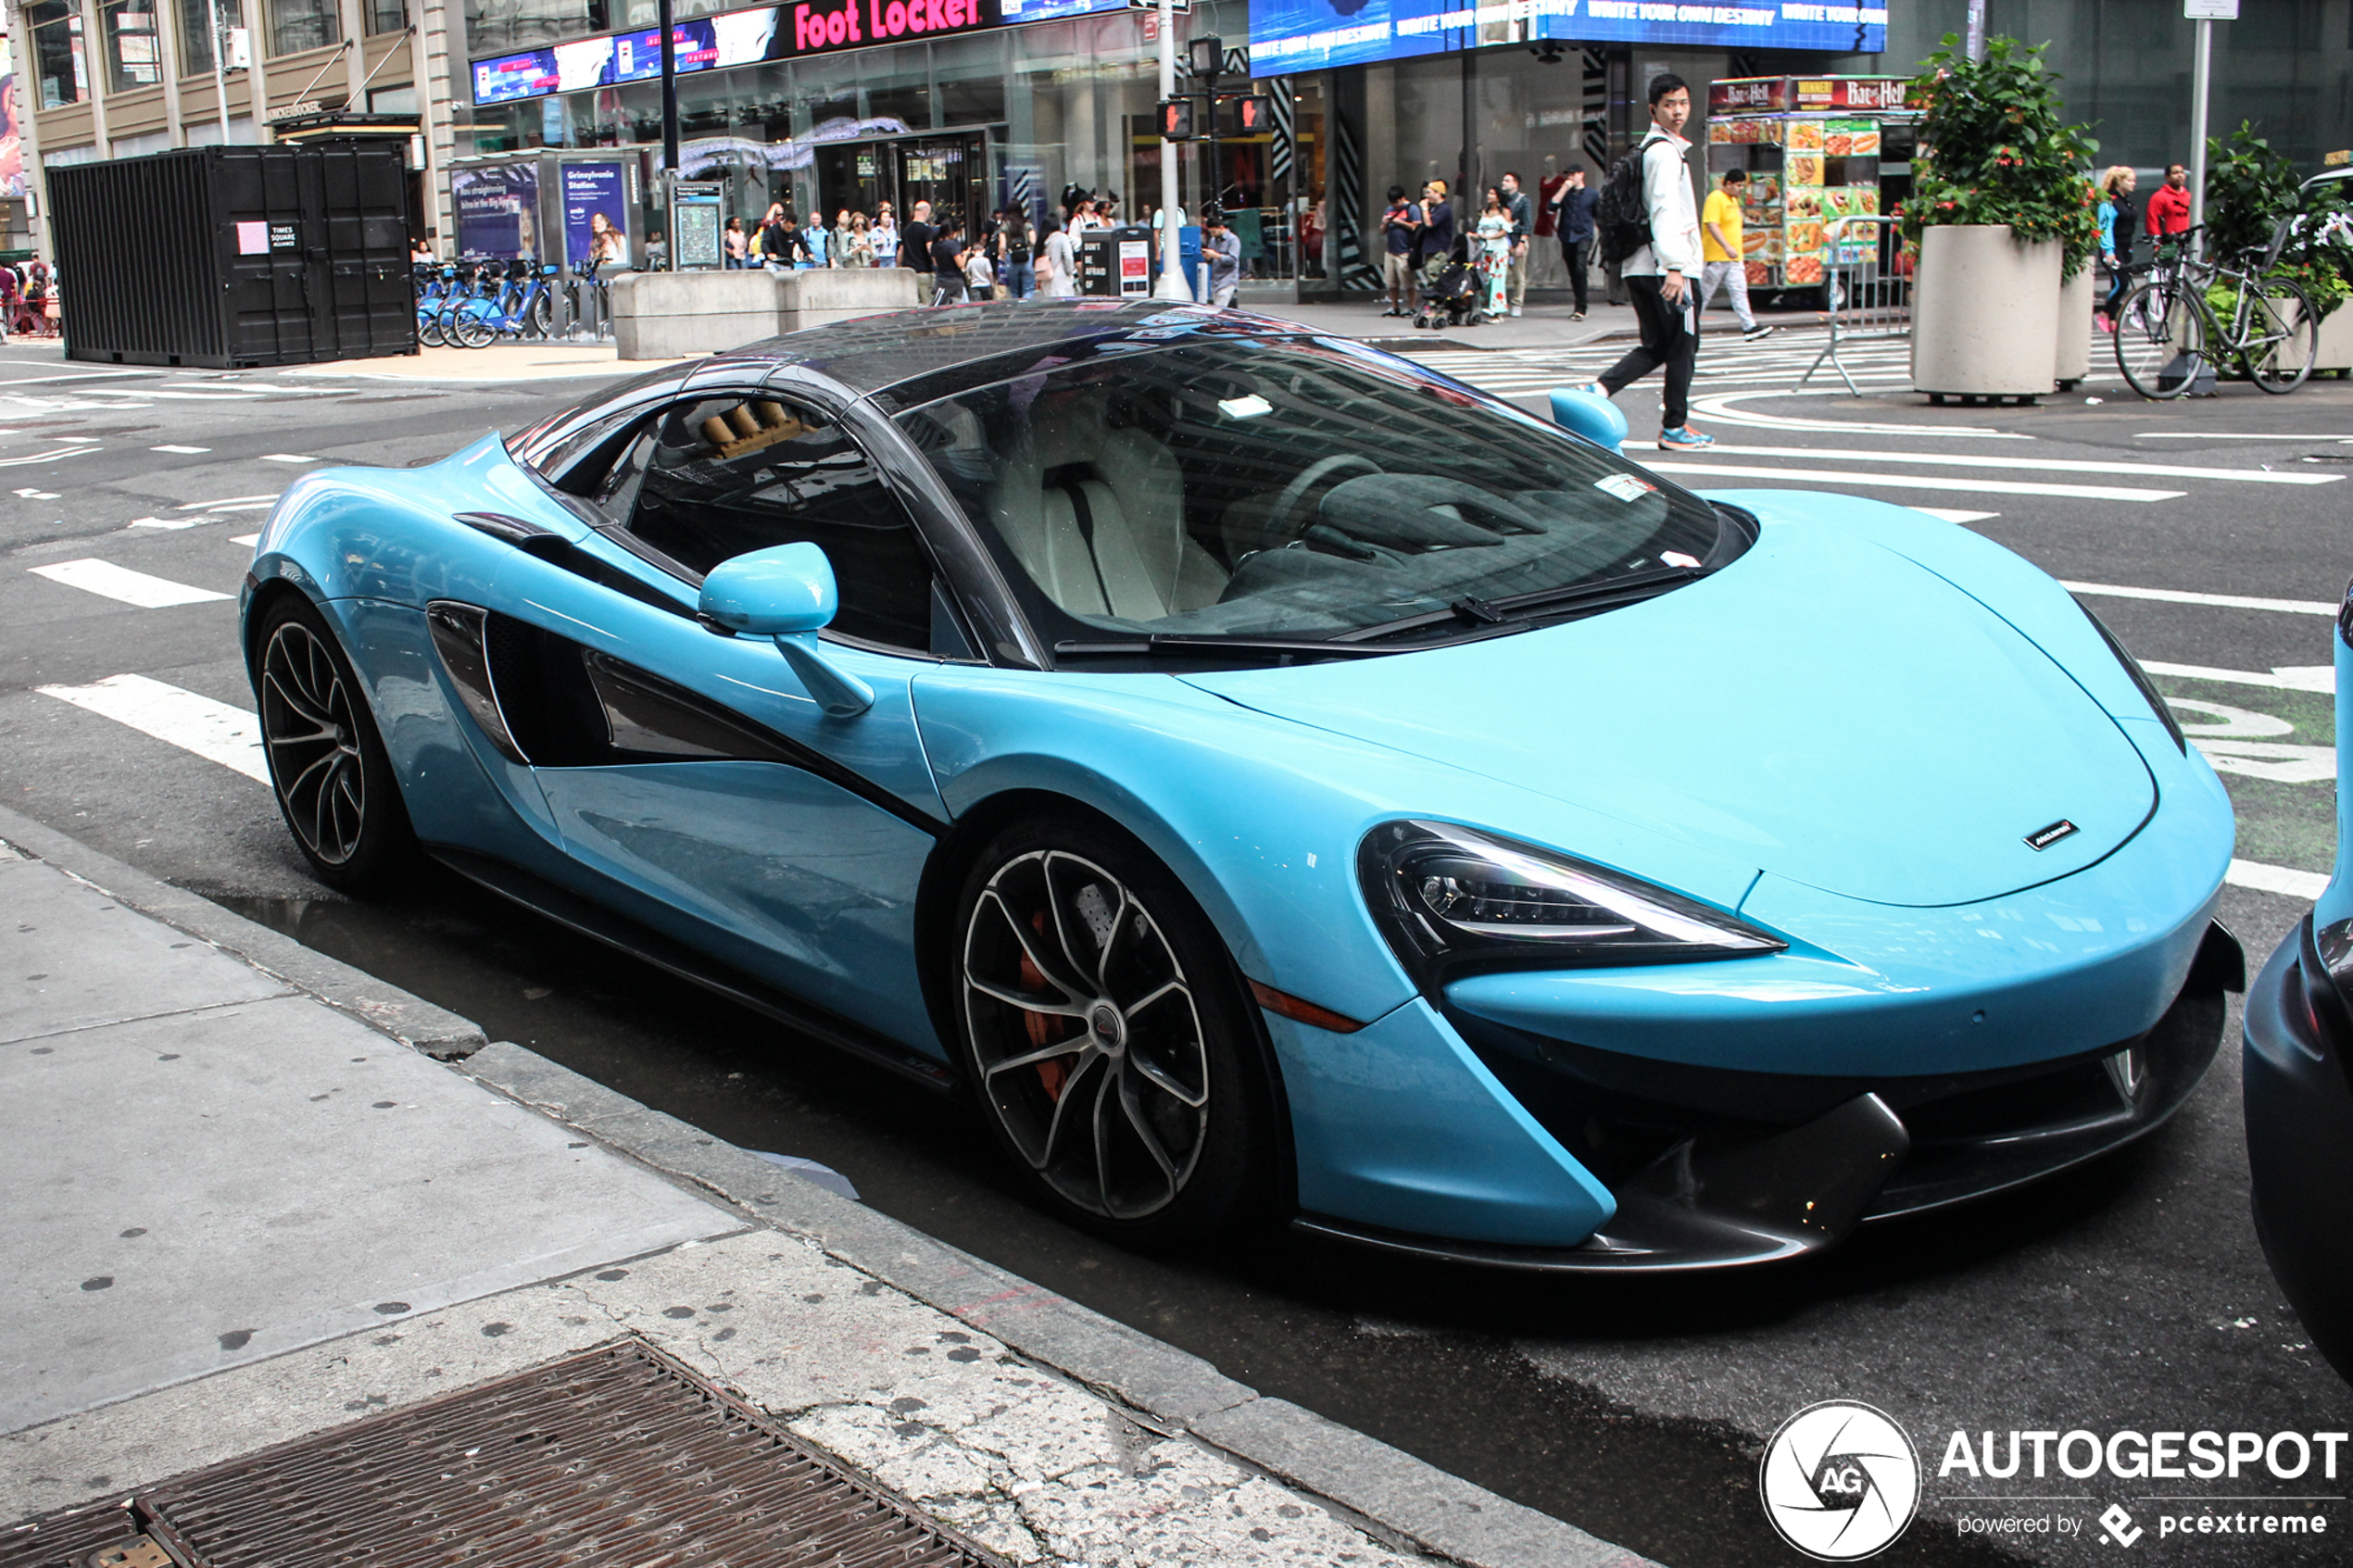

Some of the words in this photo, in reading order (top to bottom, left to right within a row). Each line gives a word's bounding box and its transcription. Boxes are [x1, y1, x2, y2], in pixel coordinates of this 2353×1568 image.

[1396, 15, 1439, 37] WRITE
[1439, 9, 1474, 30] YOUR
[1475, 4, 1509, 25] OWN
[1509, 0, 1578, 21] DESTINY
[1587, 1, 1637, 19] WRITE
[1638, 3, 1677, 21] YOUR
[1677, 5, 1713, 24] OWN
[1714, 7, 1776, 26] DESTINY
[1781, 3, 1824, 21] WRITE
[1825, 6, 1858, 23] YOUR
[1859, 7, 1889, 25] OWN
[794, 0, 862, 50] Foot
[870, 0, 977, 39] Locker
[1280, 35, 1308, 56] YOUR
[1308, 31, 1336, 50] OWN
[1336, 21, 1391, 45] DESTINY
[1880, 81, 1906, 108] Hell
[567, 170, 614, 181] Grinsylvania
[568, 181, 598, 190] Station.
[271, 233, 296, 242] SQUARE
[1084, 243, 1101, 251] DON'T
[1085, 255, 1093, 264] BE
[1085, 267, 1106, 276] AFRAID
[1085, 280, 1093, 289] OF
[2035, 825, 2071, 846] McLaren
